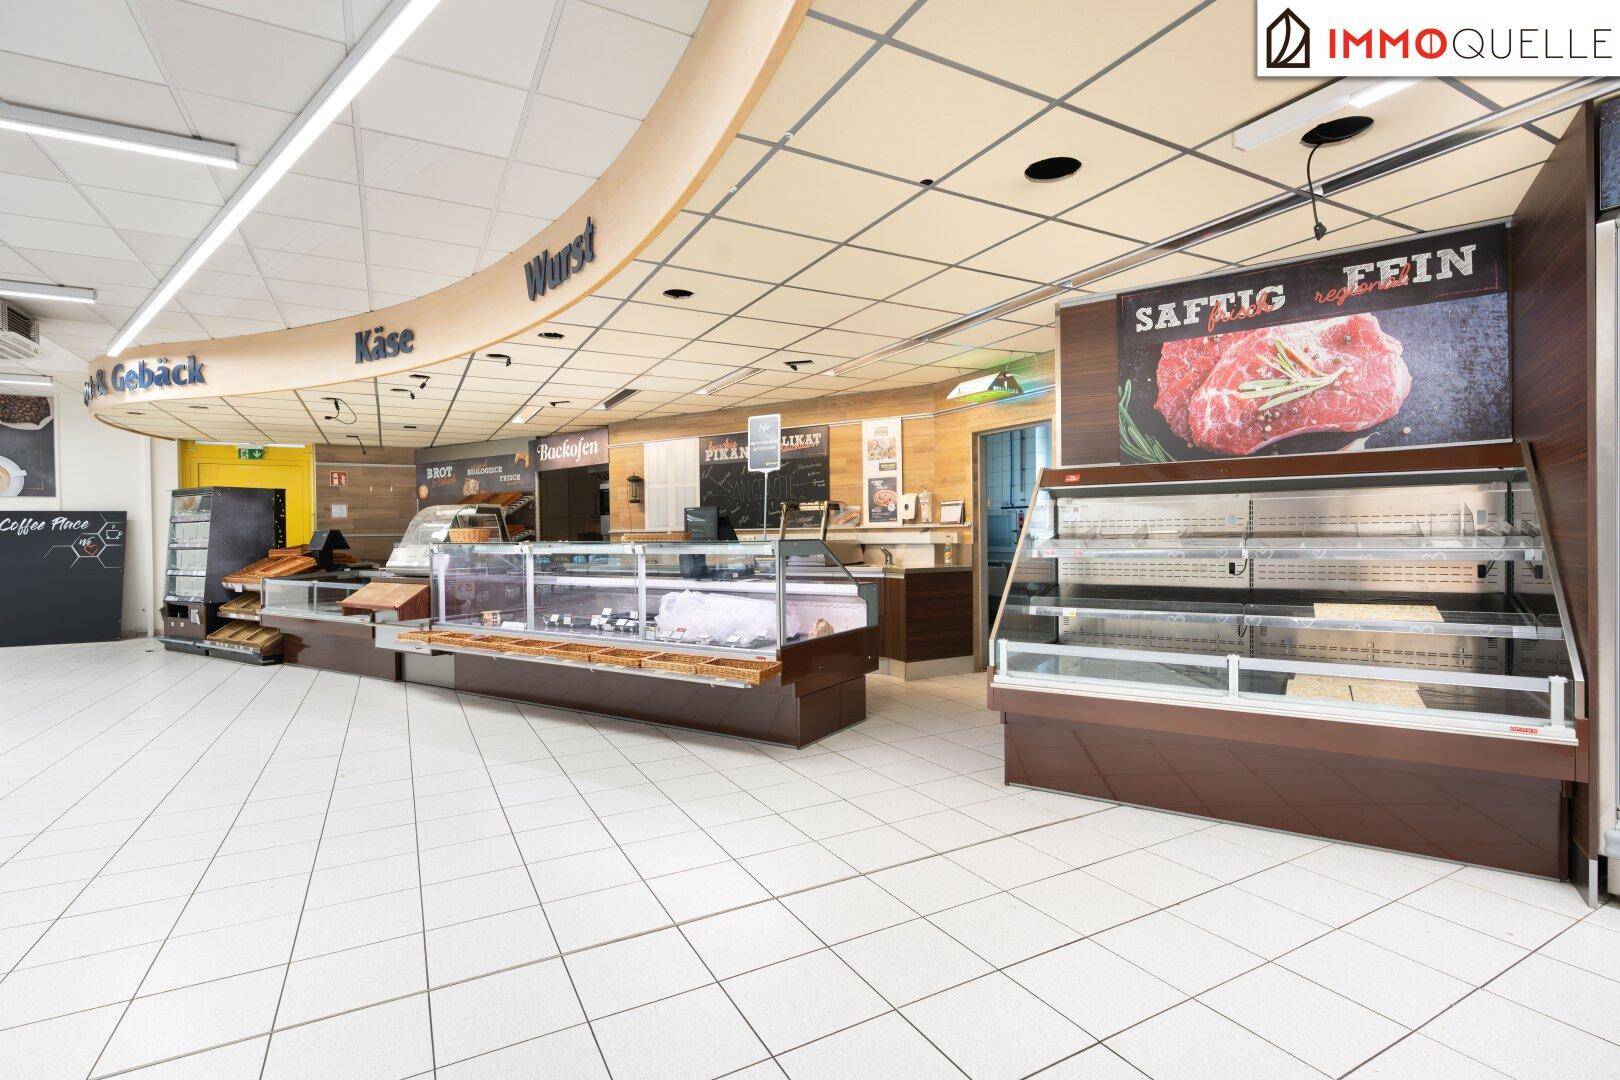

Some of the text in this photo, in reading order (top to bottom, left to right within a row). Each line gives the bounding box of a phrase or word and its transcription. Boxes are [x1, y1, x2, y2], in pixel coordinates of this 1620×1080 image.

[523, 216, 597, 302] Wurst
[1342, 244, 1477, 293] FEIN
[1314, 262, 1411, 306] regional
[1135, 285, 1286, 333] SAFTIG
[1207, 292, 1276, 333] frisch
[354, 326, 415, 364] Käse
[111, 354, 207, 392] Gebäck
[536, 436, 598, 463] Backofen
[704, 433, 822, 461] PIKAN LIKAT
[426, 466, 453, 479] BROT
[499, 473, 521, 482] FRISCH
[0, 516, 91, 536] Coffee Place
